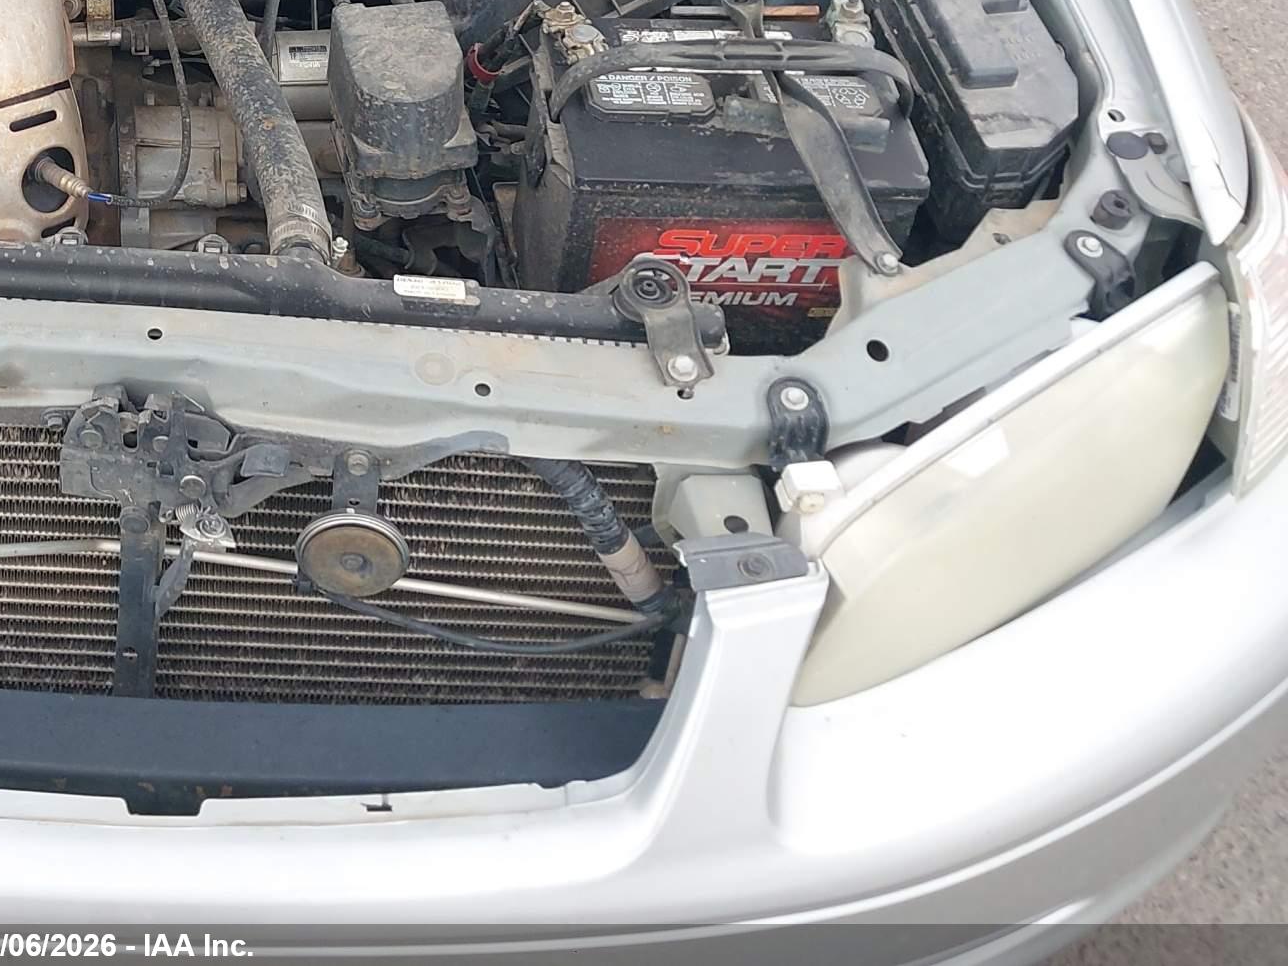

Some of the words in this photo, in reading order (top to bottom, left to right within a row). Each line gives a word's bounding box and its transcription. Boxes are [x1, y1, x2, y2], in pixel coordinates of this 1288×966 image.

[608, 74, 647, 82] DANGER
[657, 75, 692, 83] POISON
[653, 229, 848, 258] SUPER
